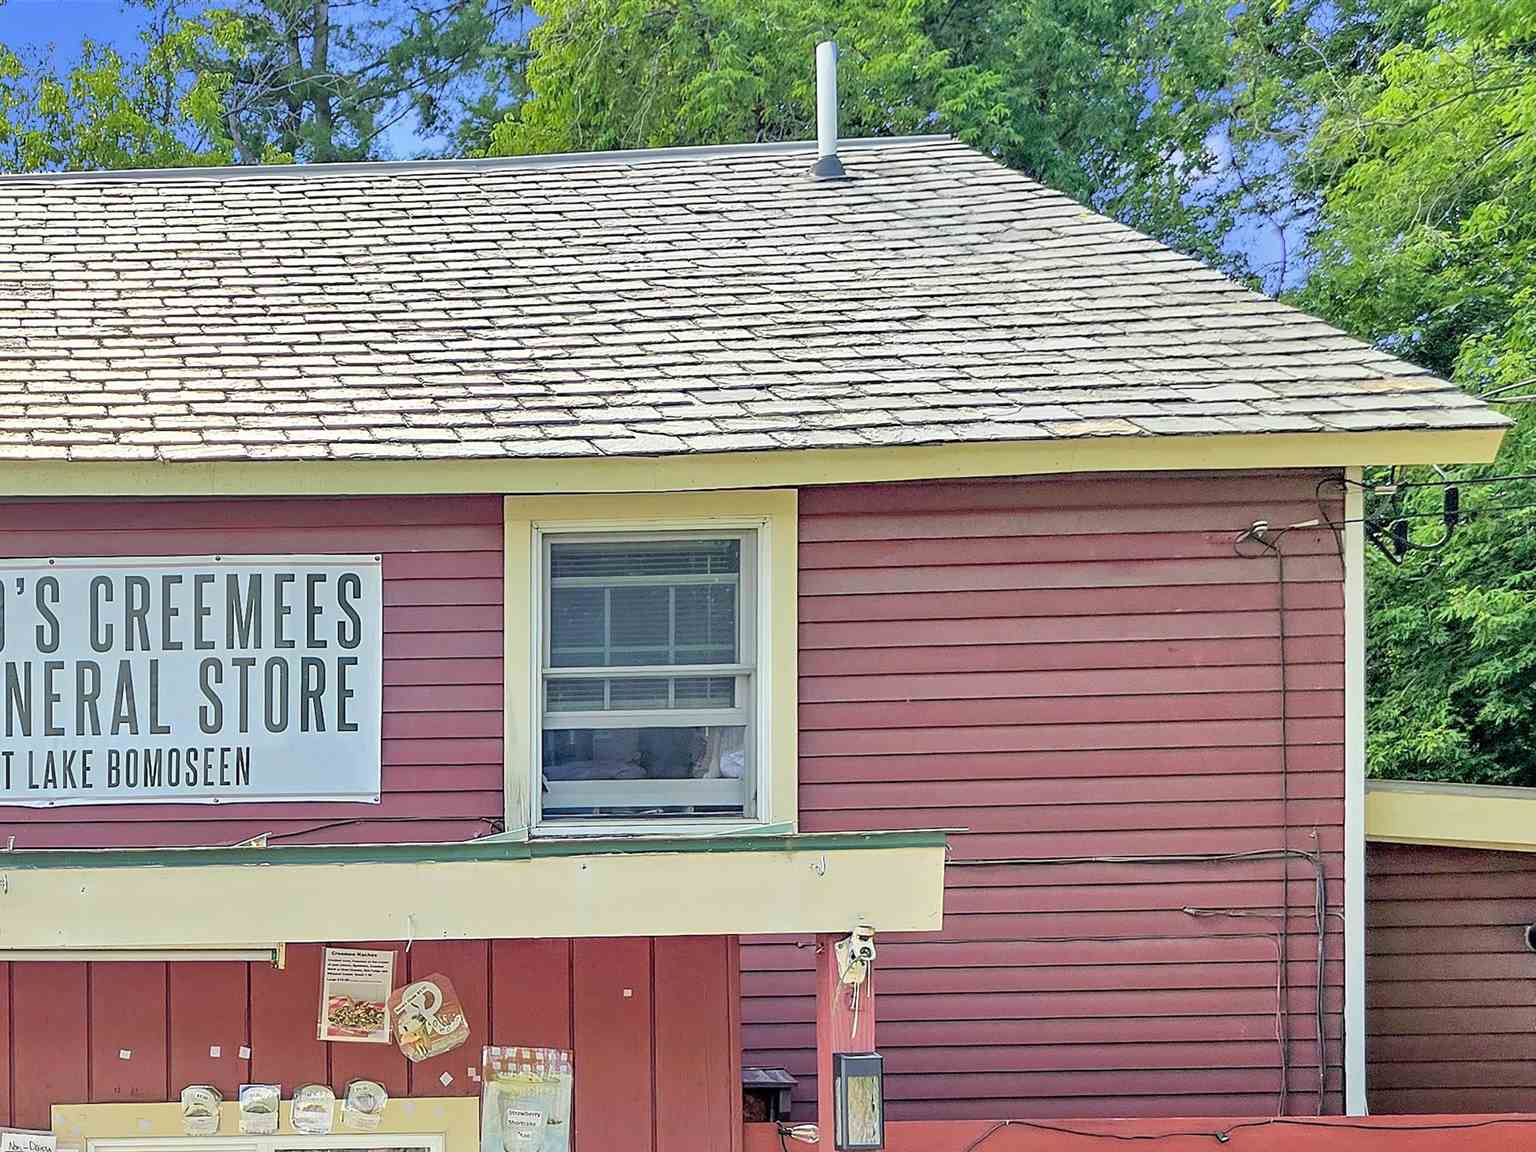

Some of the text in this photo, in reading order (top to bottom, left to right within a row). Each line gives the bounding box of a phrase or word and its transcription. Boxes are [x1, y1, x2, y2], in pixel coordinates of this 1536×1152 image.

[90, 572, 362, 654] CREEMEES
[198, 656, 359, 734] STORE
[27, 749, 94, 790] LAKE
[107, 746, 252, 789] BOMOSEEN
